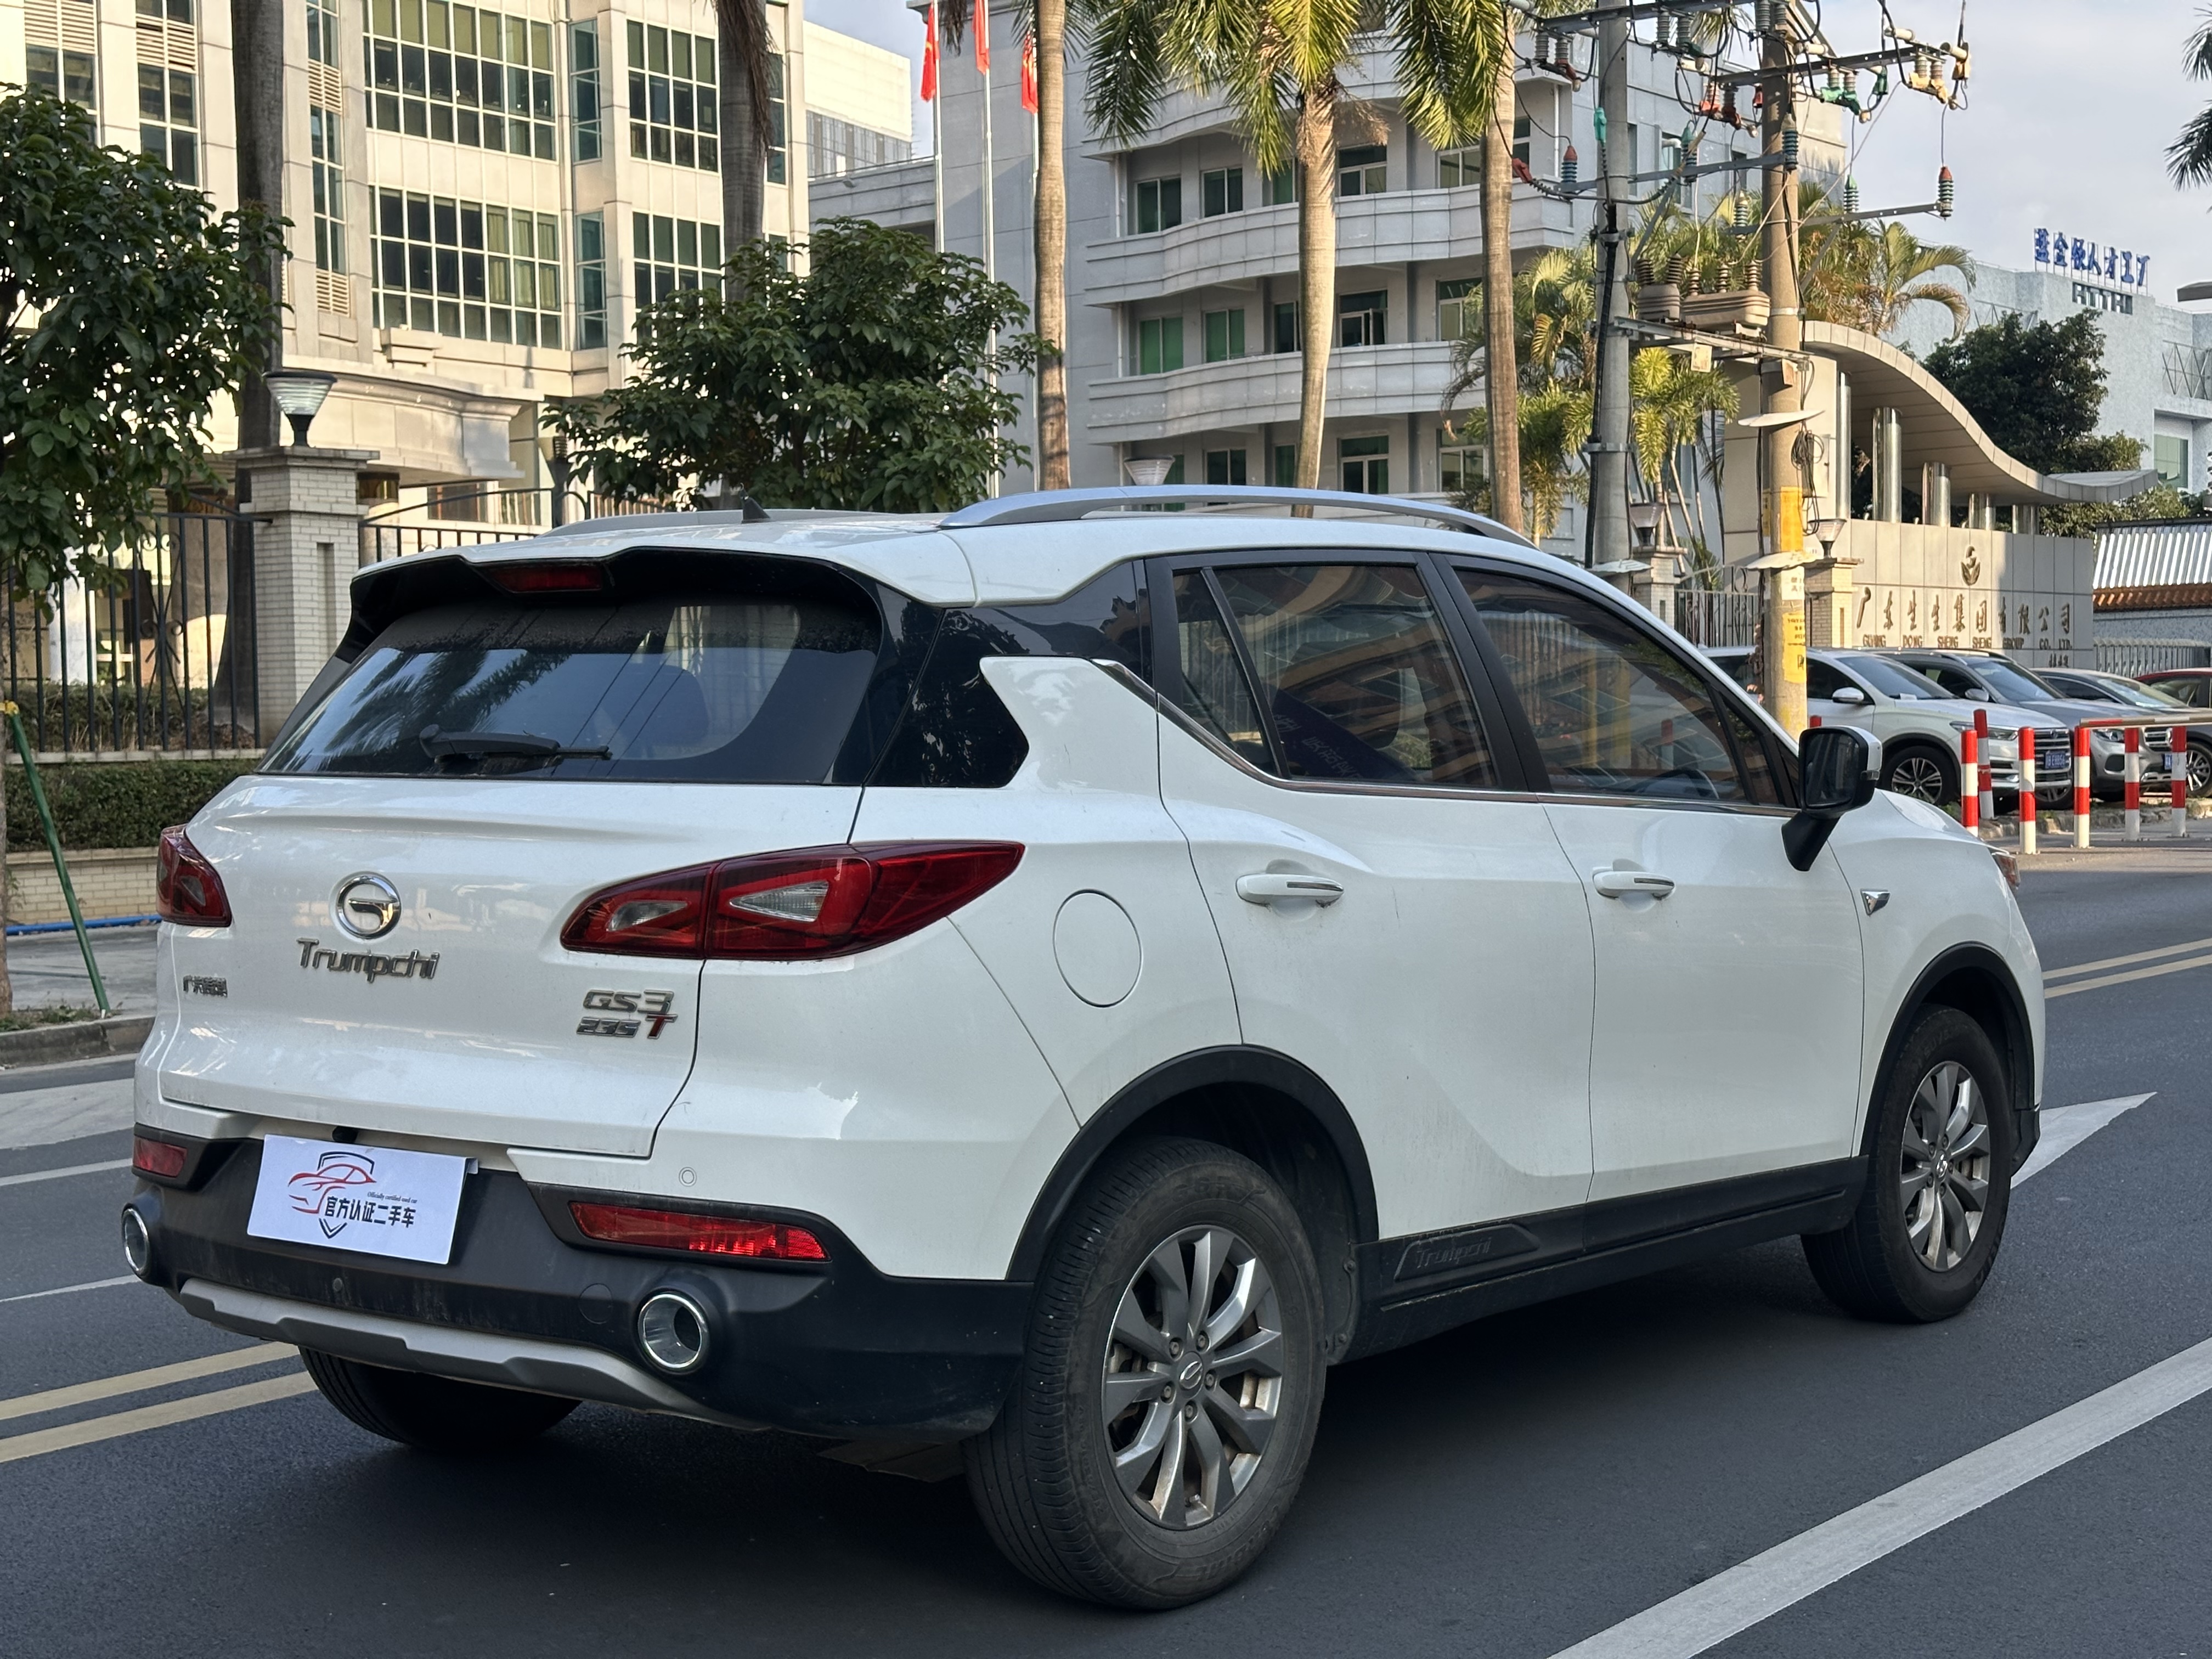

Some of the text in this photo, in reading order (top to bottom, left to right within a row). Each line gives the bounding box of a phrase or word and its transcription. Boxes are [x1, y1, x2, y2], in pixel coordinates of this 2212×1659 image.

[1856, 586, 2070, 635] 广东生生集团有限公司
[1903, 635, 1922, 648] DONG
[1937, 636, 1959, 648] SHENG
[1972, 636, 1991, 648] SHENG
[2002, 637, 2024, 650] GROUP
[2059, 639, 2073, 651] LTD.
[296, 937, 440, 984] Trumpchi
[583, 989, 674, 1014] GS3
[325, 1197, 416, 1228] 官方认证二手车
